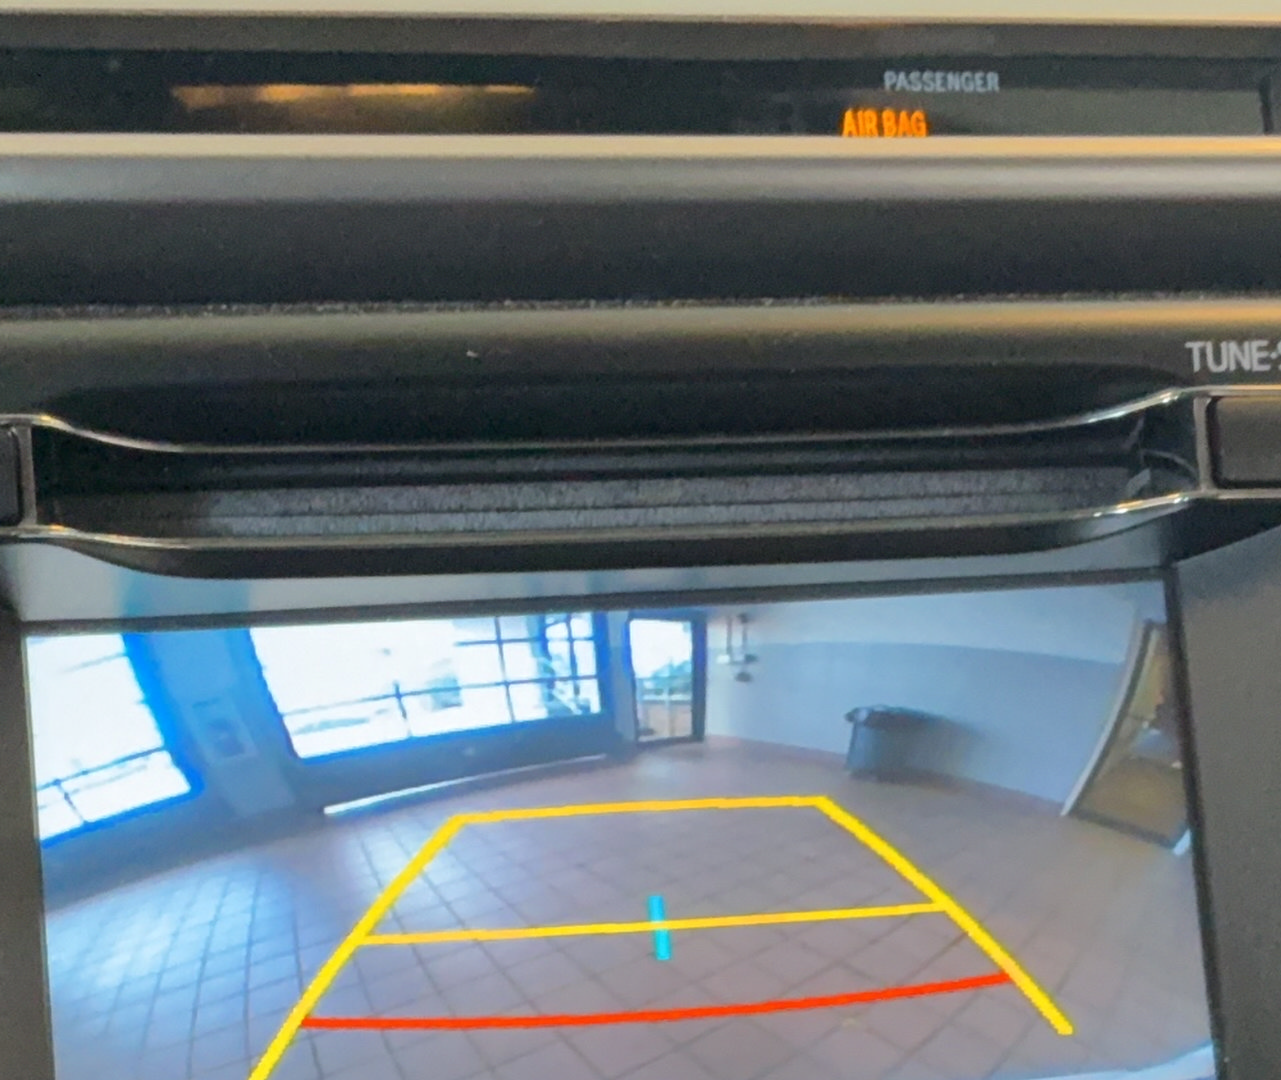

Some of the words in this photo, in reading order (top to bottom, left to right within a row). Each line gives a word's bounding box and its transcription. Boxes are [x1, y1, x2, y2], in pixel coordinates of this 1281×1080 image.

[883, 69, 1001, 93] PASSENGER
[842, 108, 879, 137] AIR
[881, 108, 929, 137] BAG
